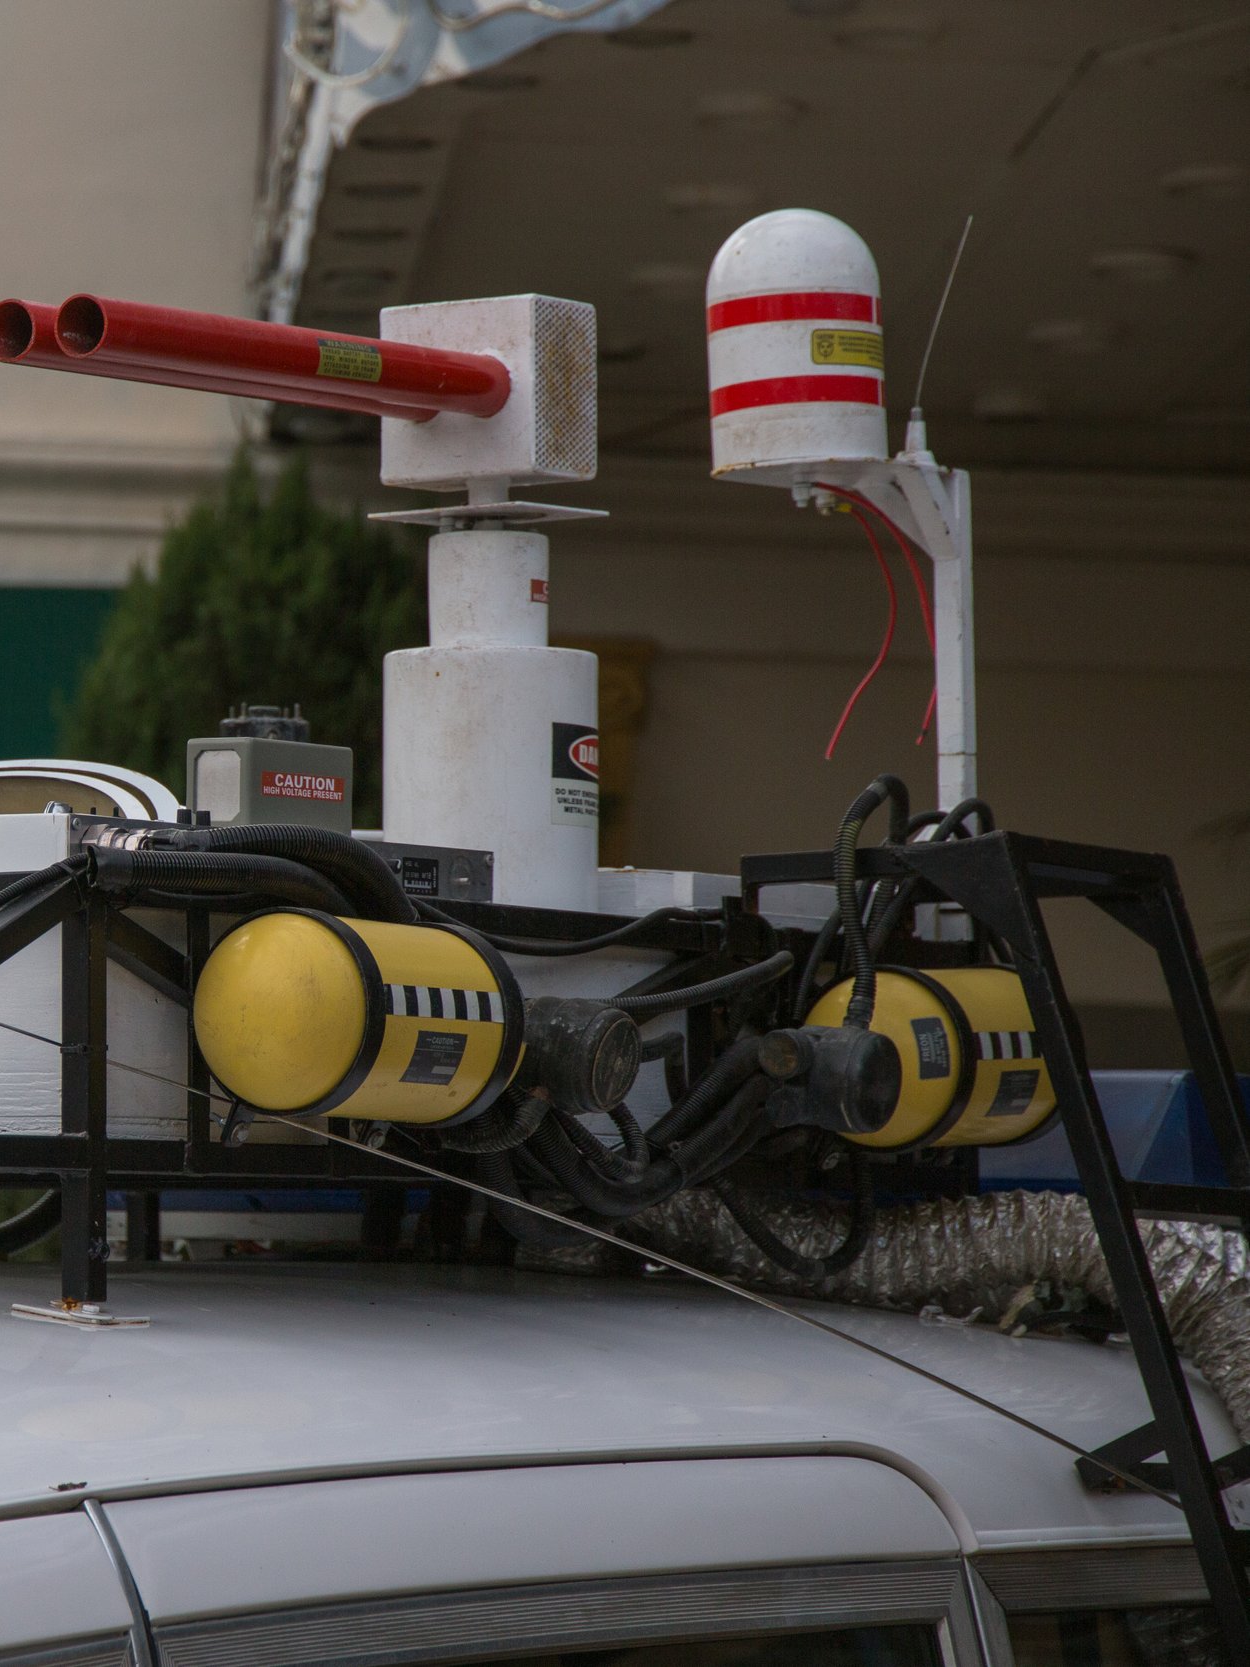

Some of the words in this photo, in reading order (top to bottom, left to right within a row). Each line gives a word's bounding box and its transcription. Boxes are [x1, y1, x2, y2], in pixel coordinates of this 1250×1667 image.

[275, 774, 335, 791] CAUTION
[263, 786, 280, 795] HIGH
[282, 788, 311, 798] VOLTAGE
[313, 790, 342, 800] PRESENT
[568, 789, 580, 797] NOT
[557, 797, 582, 805] UNLESS
[564, 806, 584, 815] METAL
